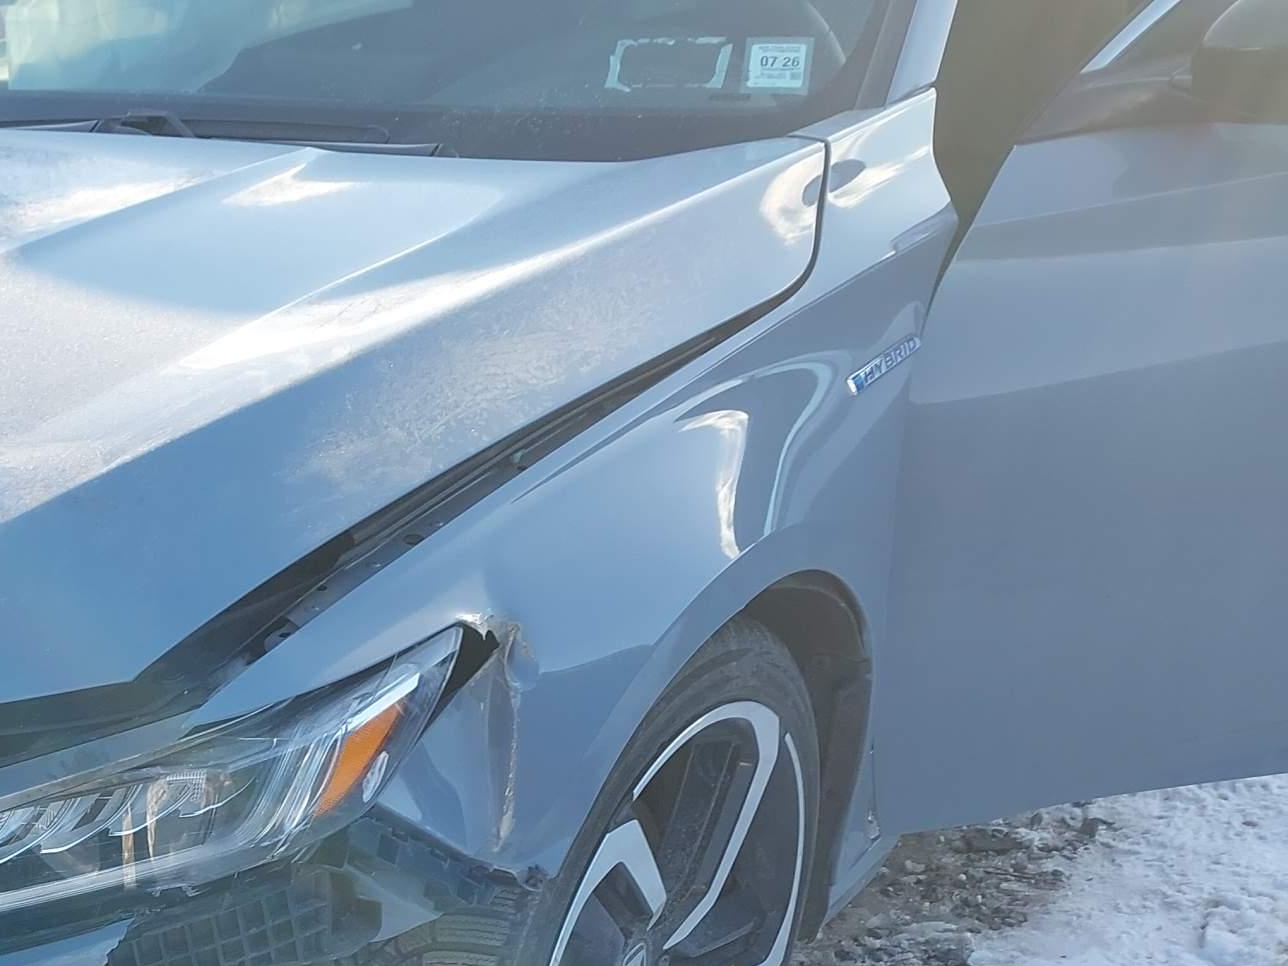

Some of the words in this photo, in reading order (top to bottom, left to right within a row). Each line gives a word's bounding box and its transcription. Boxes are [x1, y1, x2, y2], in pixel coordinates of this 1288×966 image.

[760, 55, 778, 67] 07
[782, 56, 801, 67] 26
[863, 336, 919, 384] HYBRID
